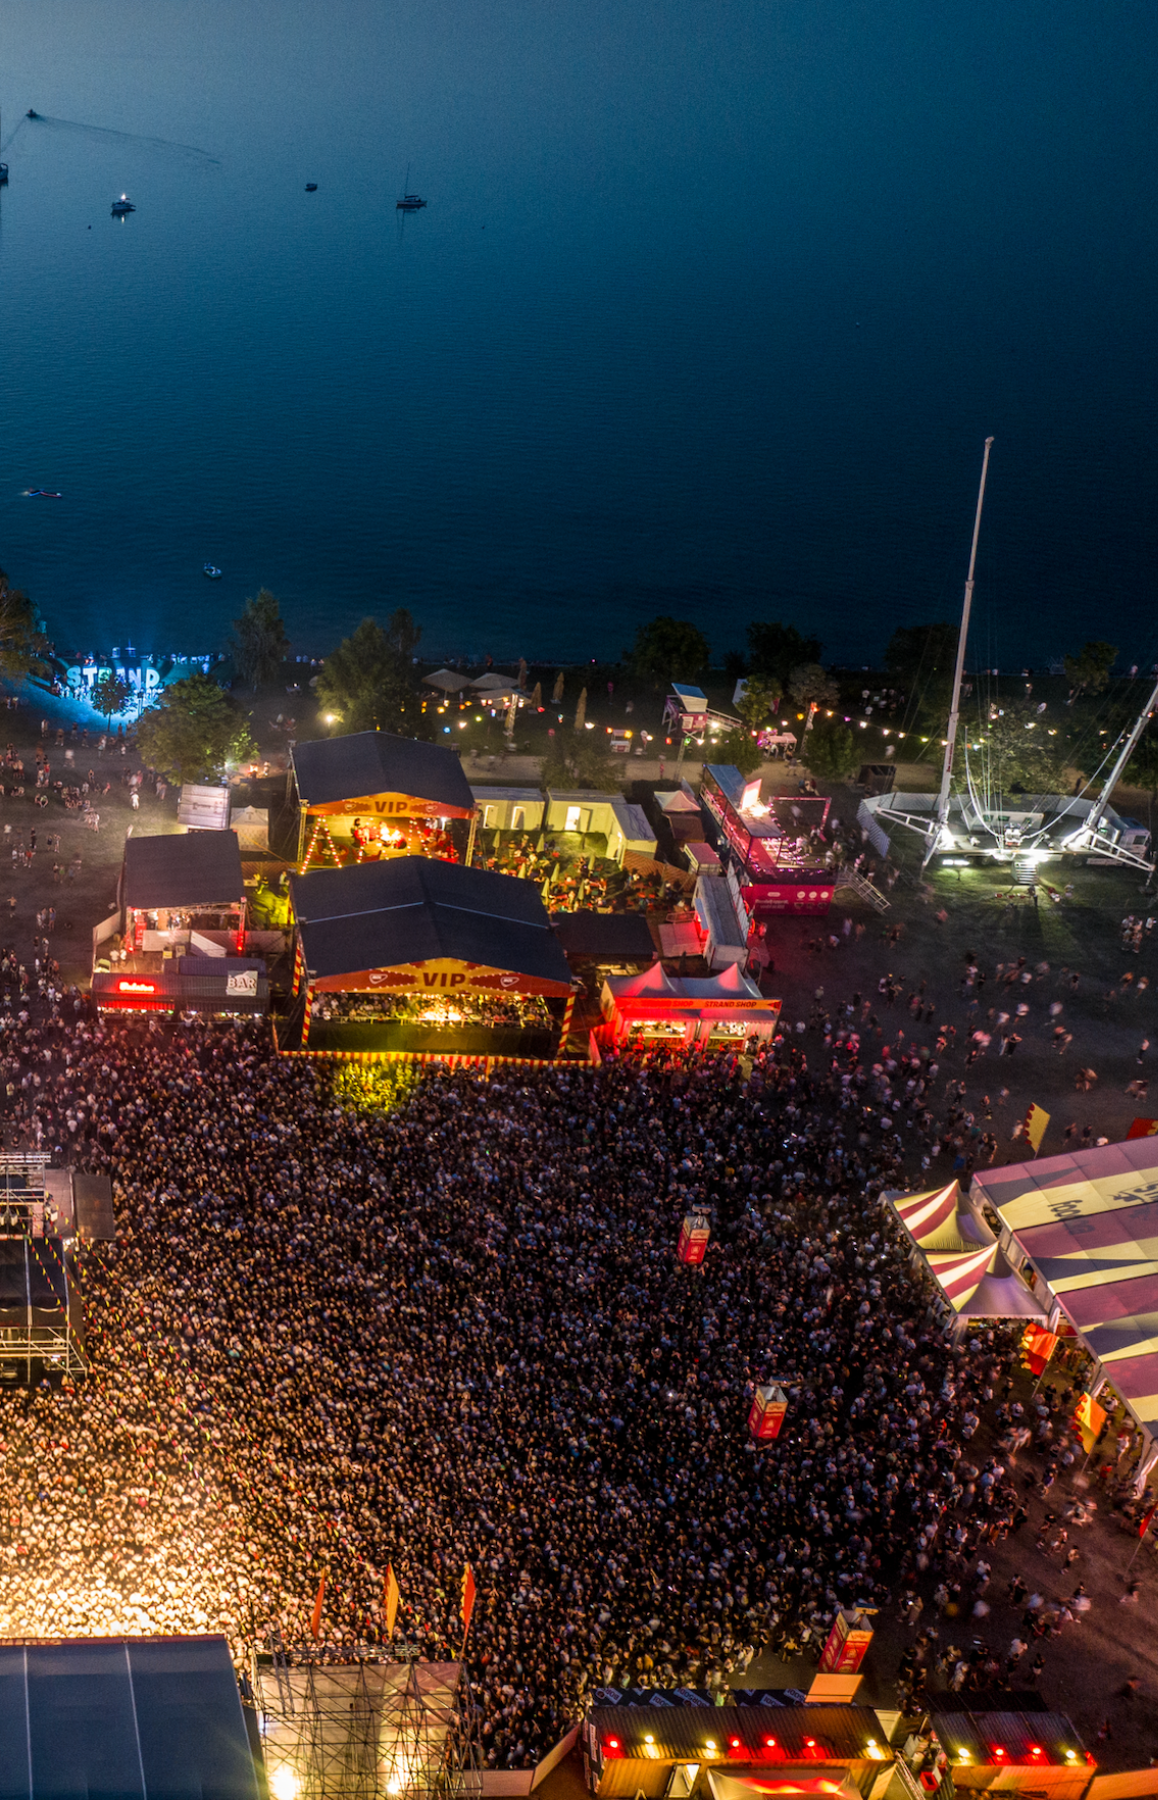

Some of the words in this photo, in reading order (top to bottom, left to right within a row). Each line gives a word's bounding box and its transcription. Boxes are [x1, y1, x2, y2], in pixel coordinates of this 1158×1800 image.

[374, 801, 408, 813] VIP
[228, 977, 256, 989] BAR
[422, 972, 466, 987] VIP
